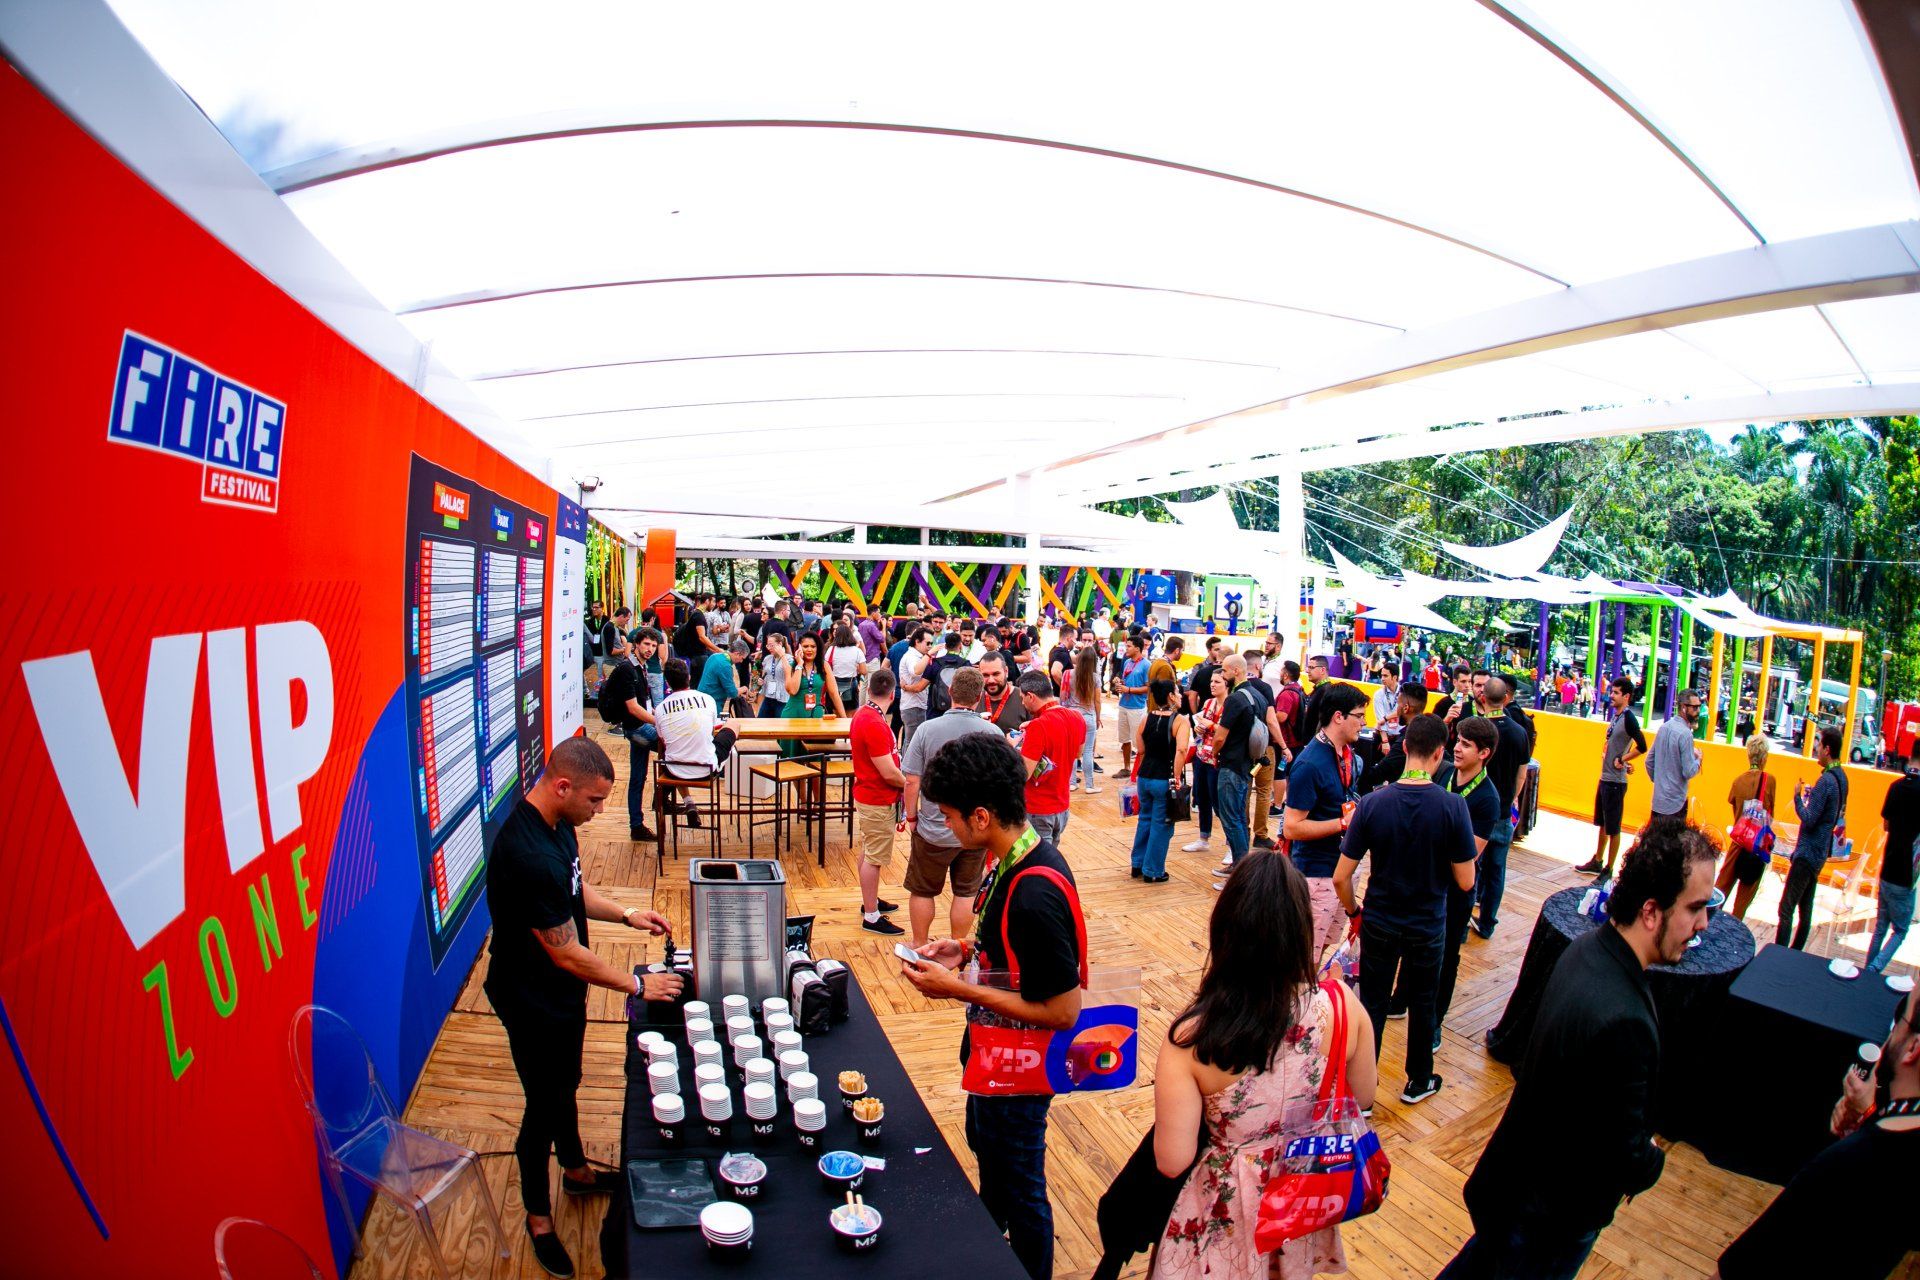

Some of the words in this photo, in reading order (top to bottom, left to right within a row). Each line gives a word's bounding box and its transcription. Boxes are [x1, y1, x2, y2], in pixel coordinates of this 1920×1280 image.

[210, 472, 271, 503] FESTIVAL
[20, 619, 335, 951] VIP
[142, 842, 318, 1082] ZONE
[979, 1046, 1042, 1073] VIP
